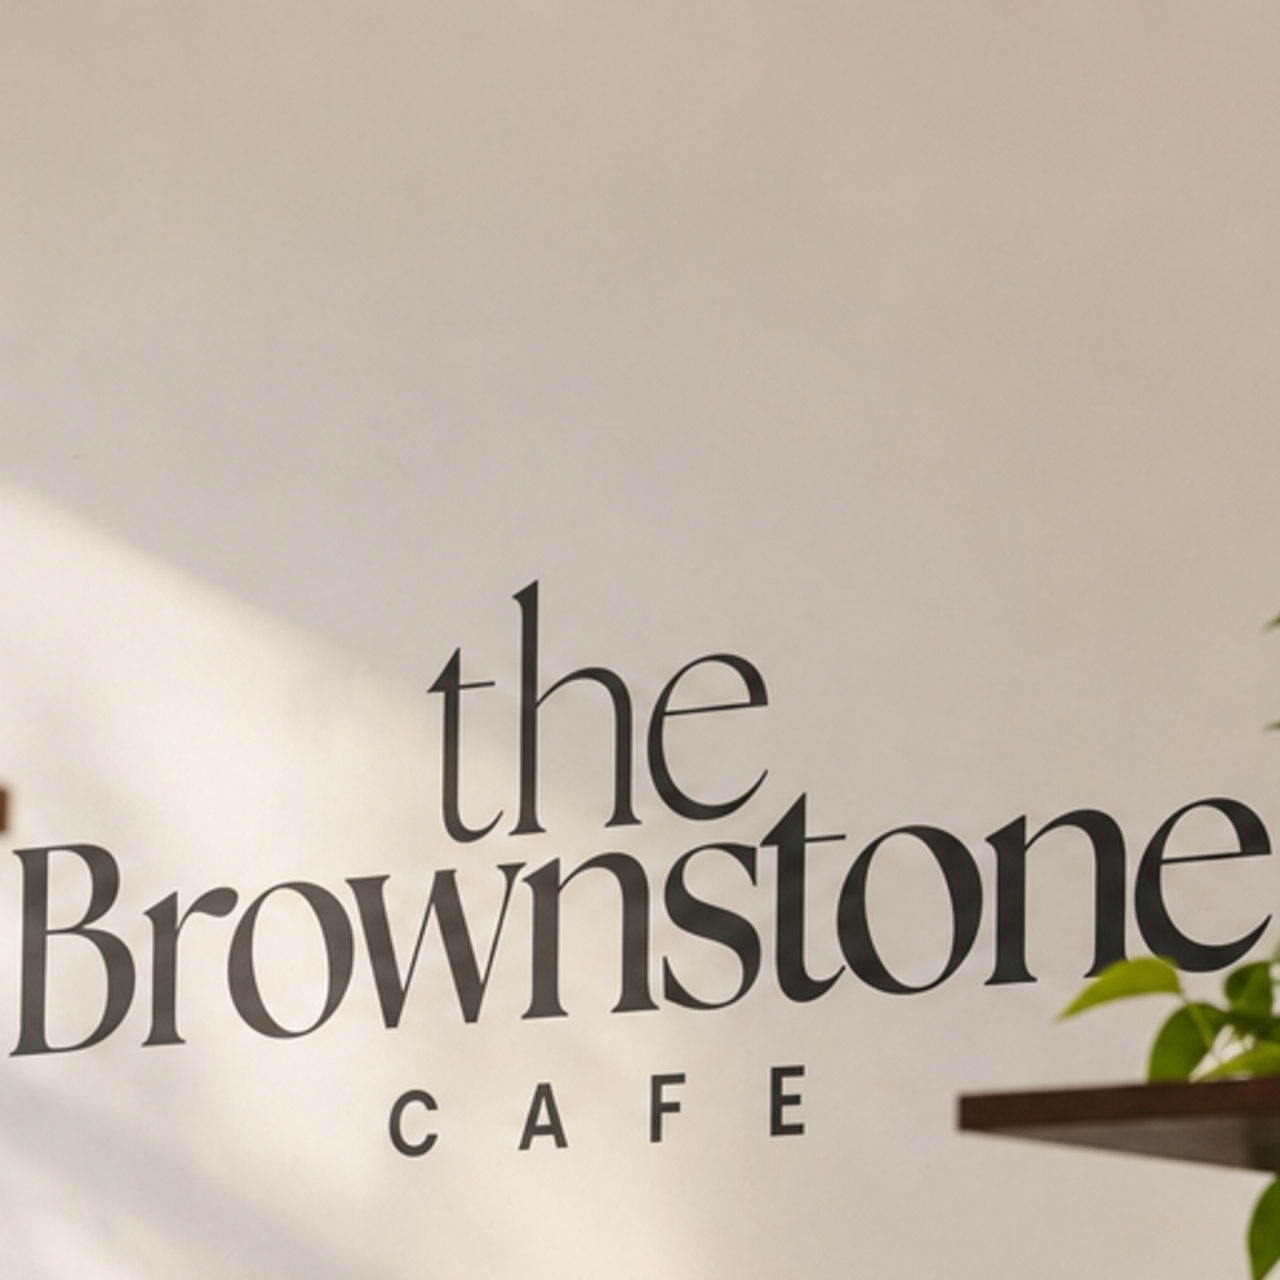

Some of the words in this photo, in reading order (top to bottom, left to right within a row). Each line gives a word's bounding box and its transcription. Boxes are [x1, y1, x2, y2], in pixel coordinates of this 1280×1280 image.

[426, 579, 770, 843] the
[9, 791, 1275, 1058] Brownstone
[388, 1064, 806, 1158] CAFE
